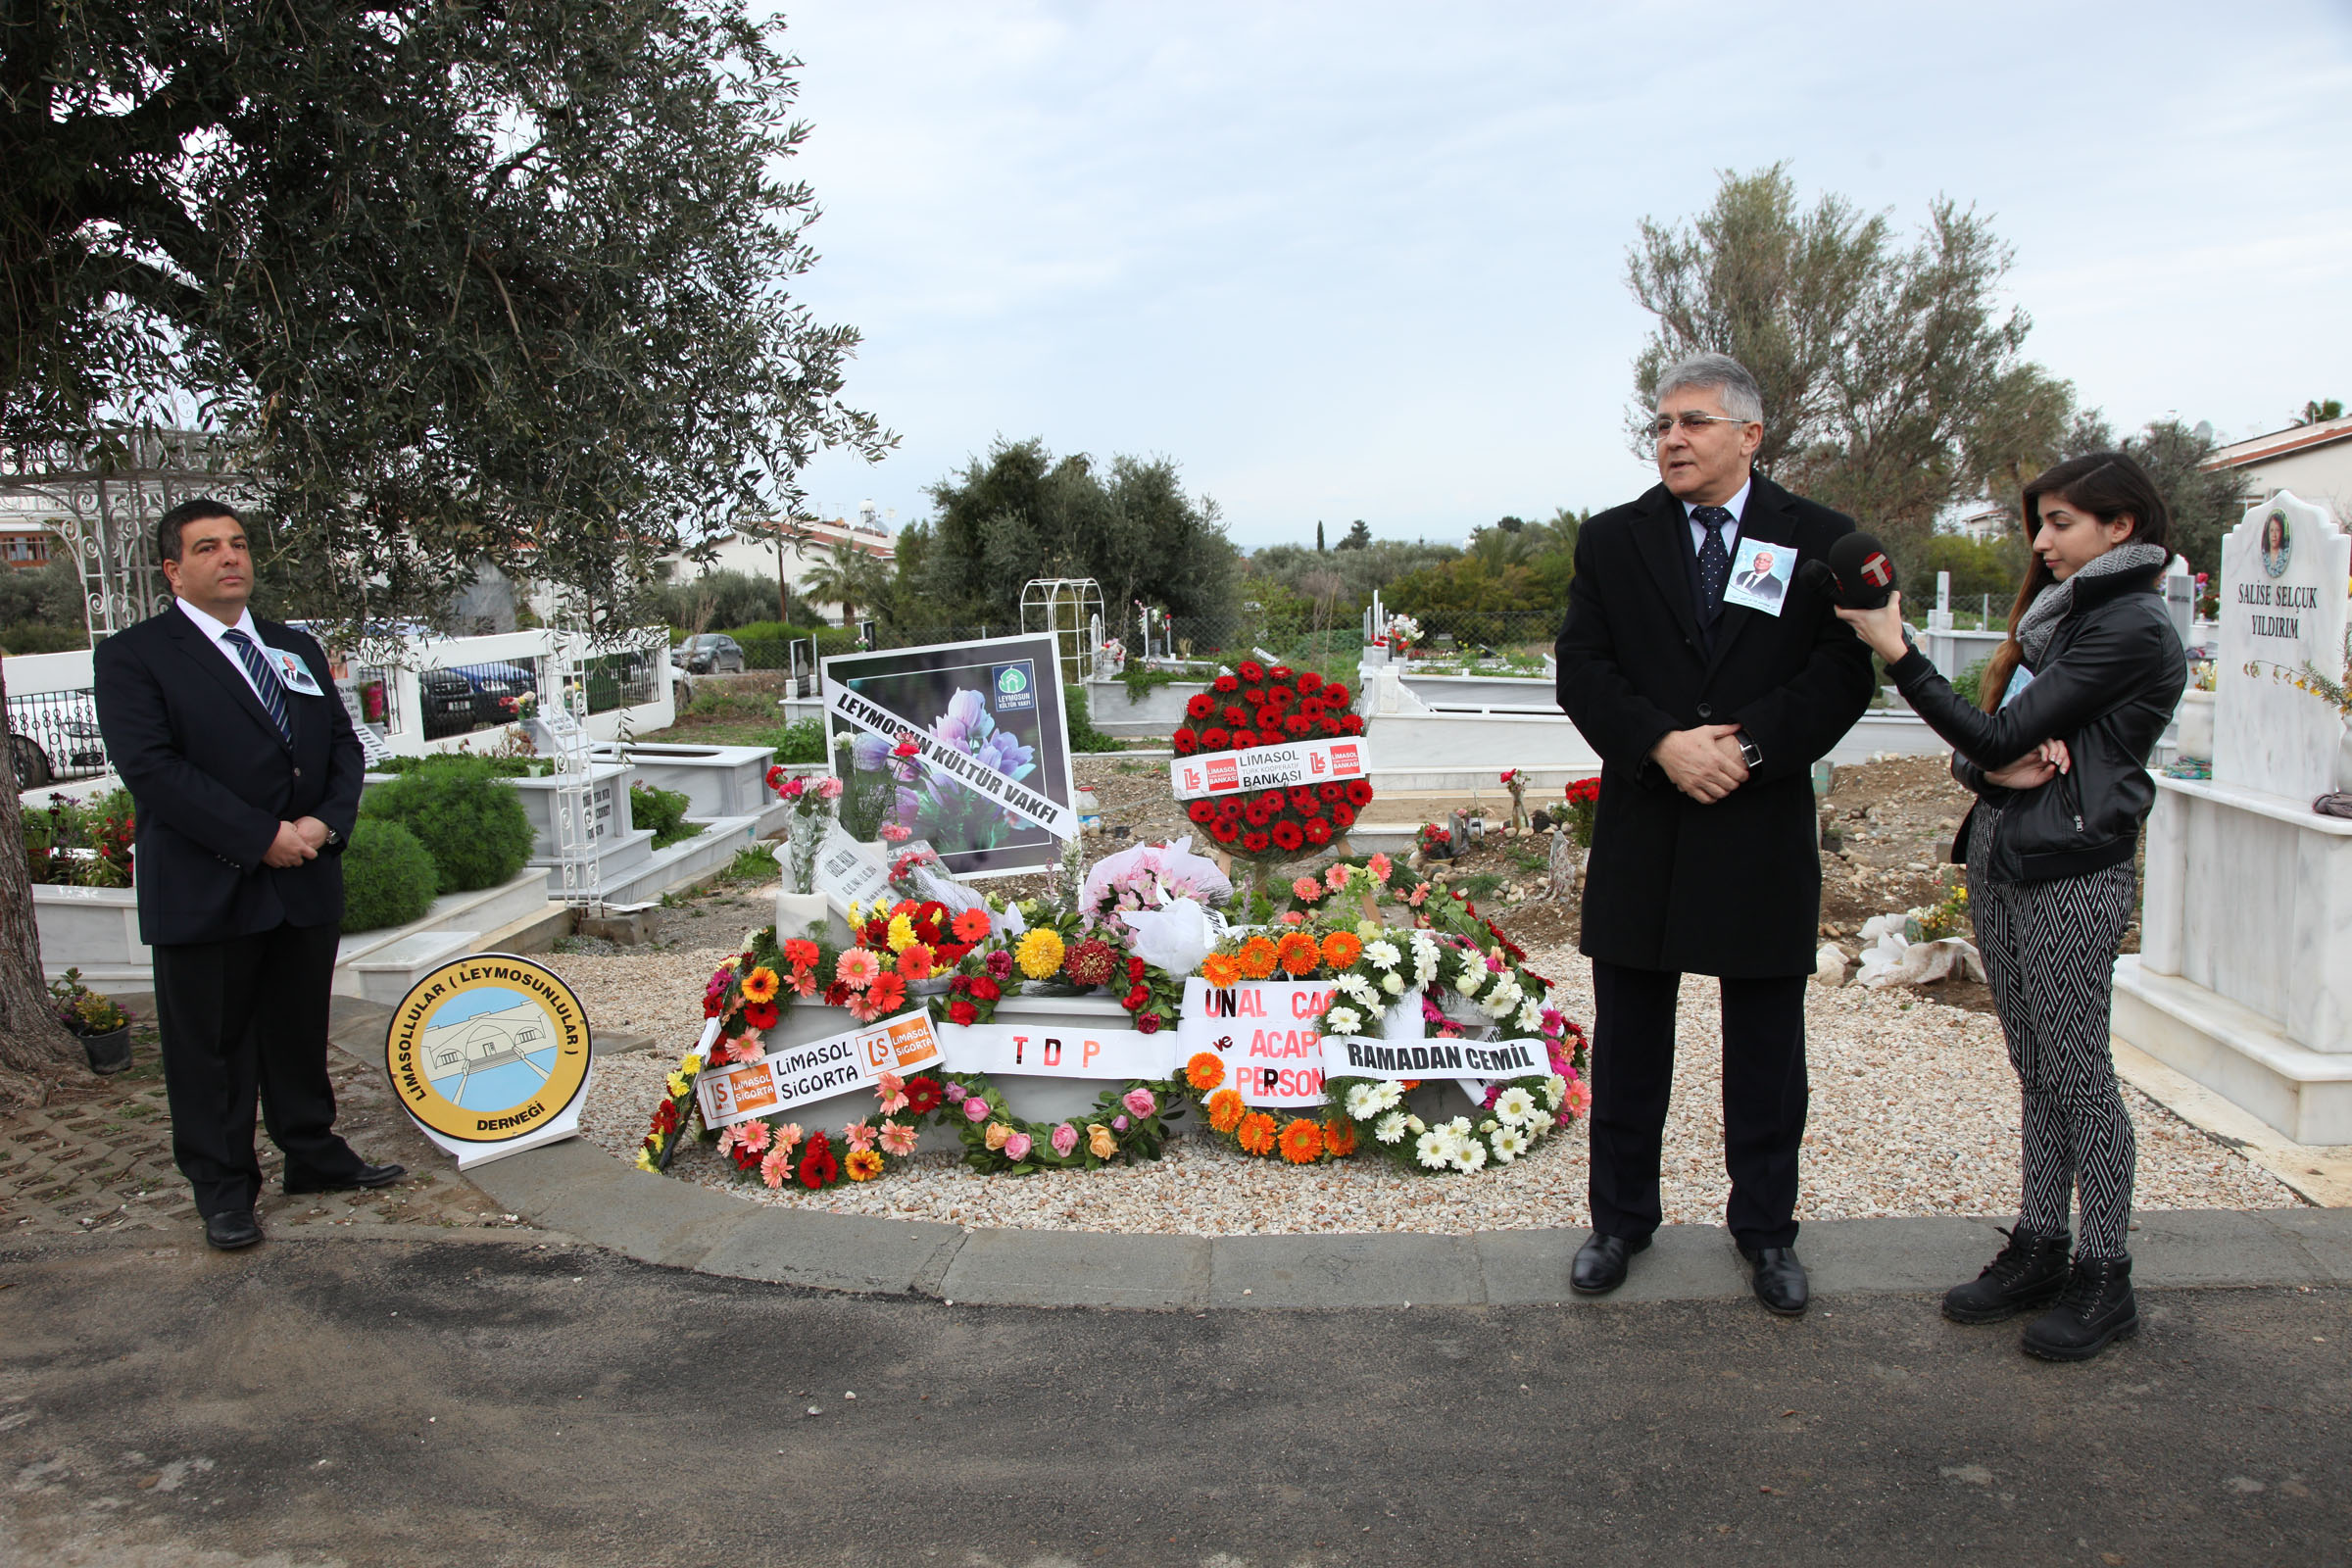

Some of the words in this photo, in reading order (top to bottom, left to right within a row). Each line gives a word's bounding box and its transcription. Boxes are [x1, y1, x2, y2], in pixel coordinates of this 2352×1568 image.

[2238, 579, 2271, 606] SALİSE
[2276, 585, 2317, 613] SELÇUK
[2252, 614, 2298, 639] YILDIRIM
[998, 692, 1030, 703] LEYMOSUN
[837, 693, 933, 755] LEYMOSN
[931, 746, 1003, 795] KÜLTÜR
[1004, 784, 1058, 824] VAKFI
[1240, 750, 1300, 766] LİMASOL
[1244, 770, 1301, 787] BANKASI
[399, 983, 446, 1102] LİMASOLLULAR
[1212, 1036, 1233, 1052] ve
[1347, 1044, 1462, 1071] RAMADAN
[1465, 1043, 1535, 1071] CEMİL
[1236, 1066, 1326, 1097] PERSON
[477, 1100, 546, 1131] DERNEĞİ
